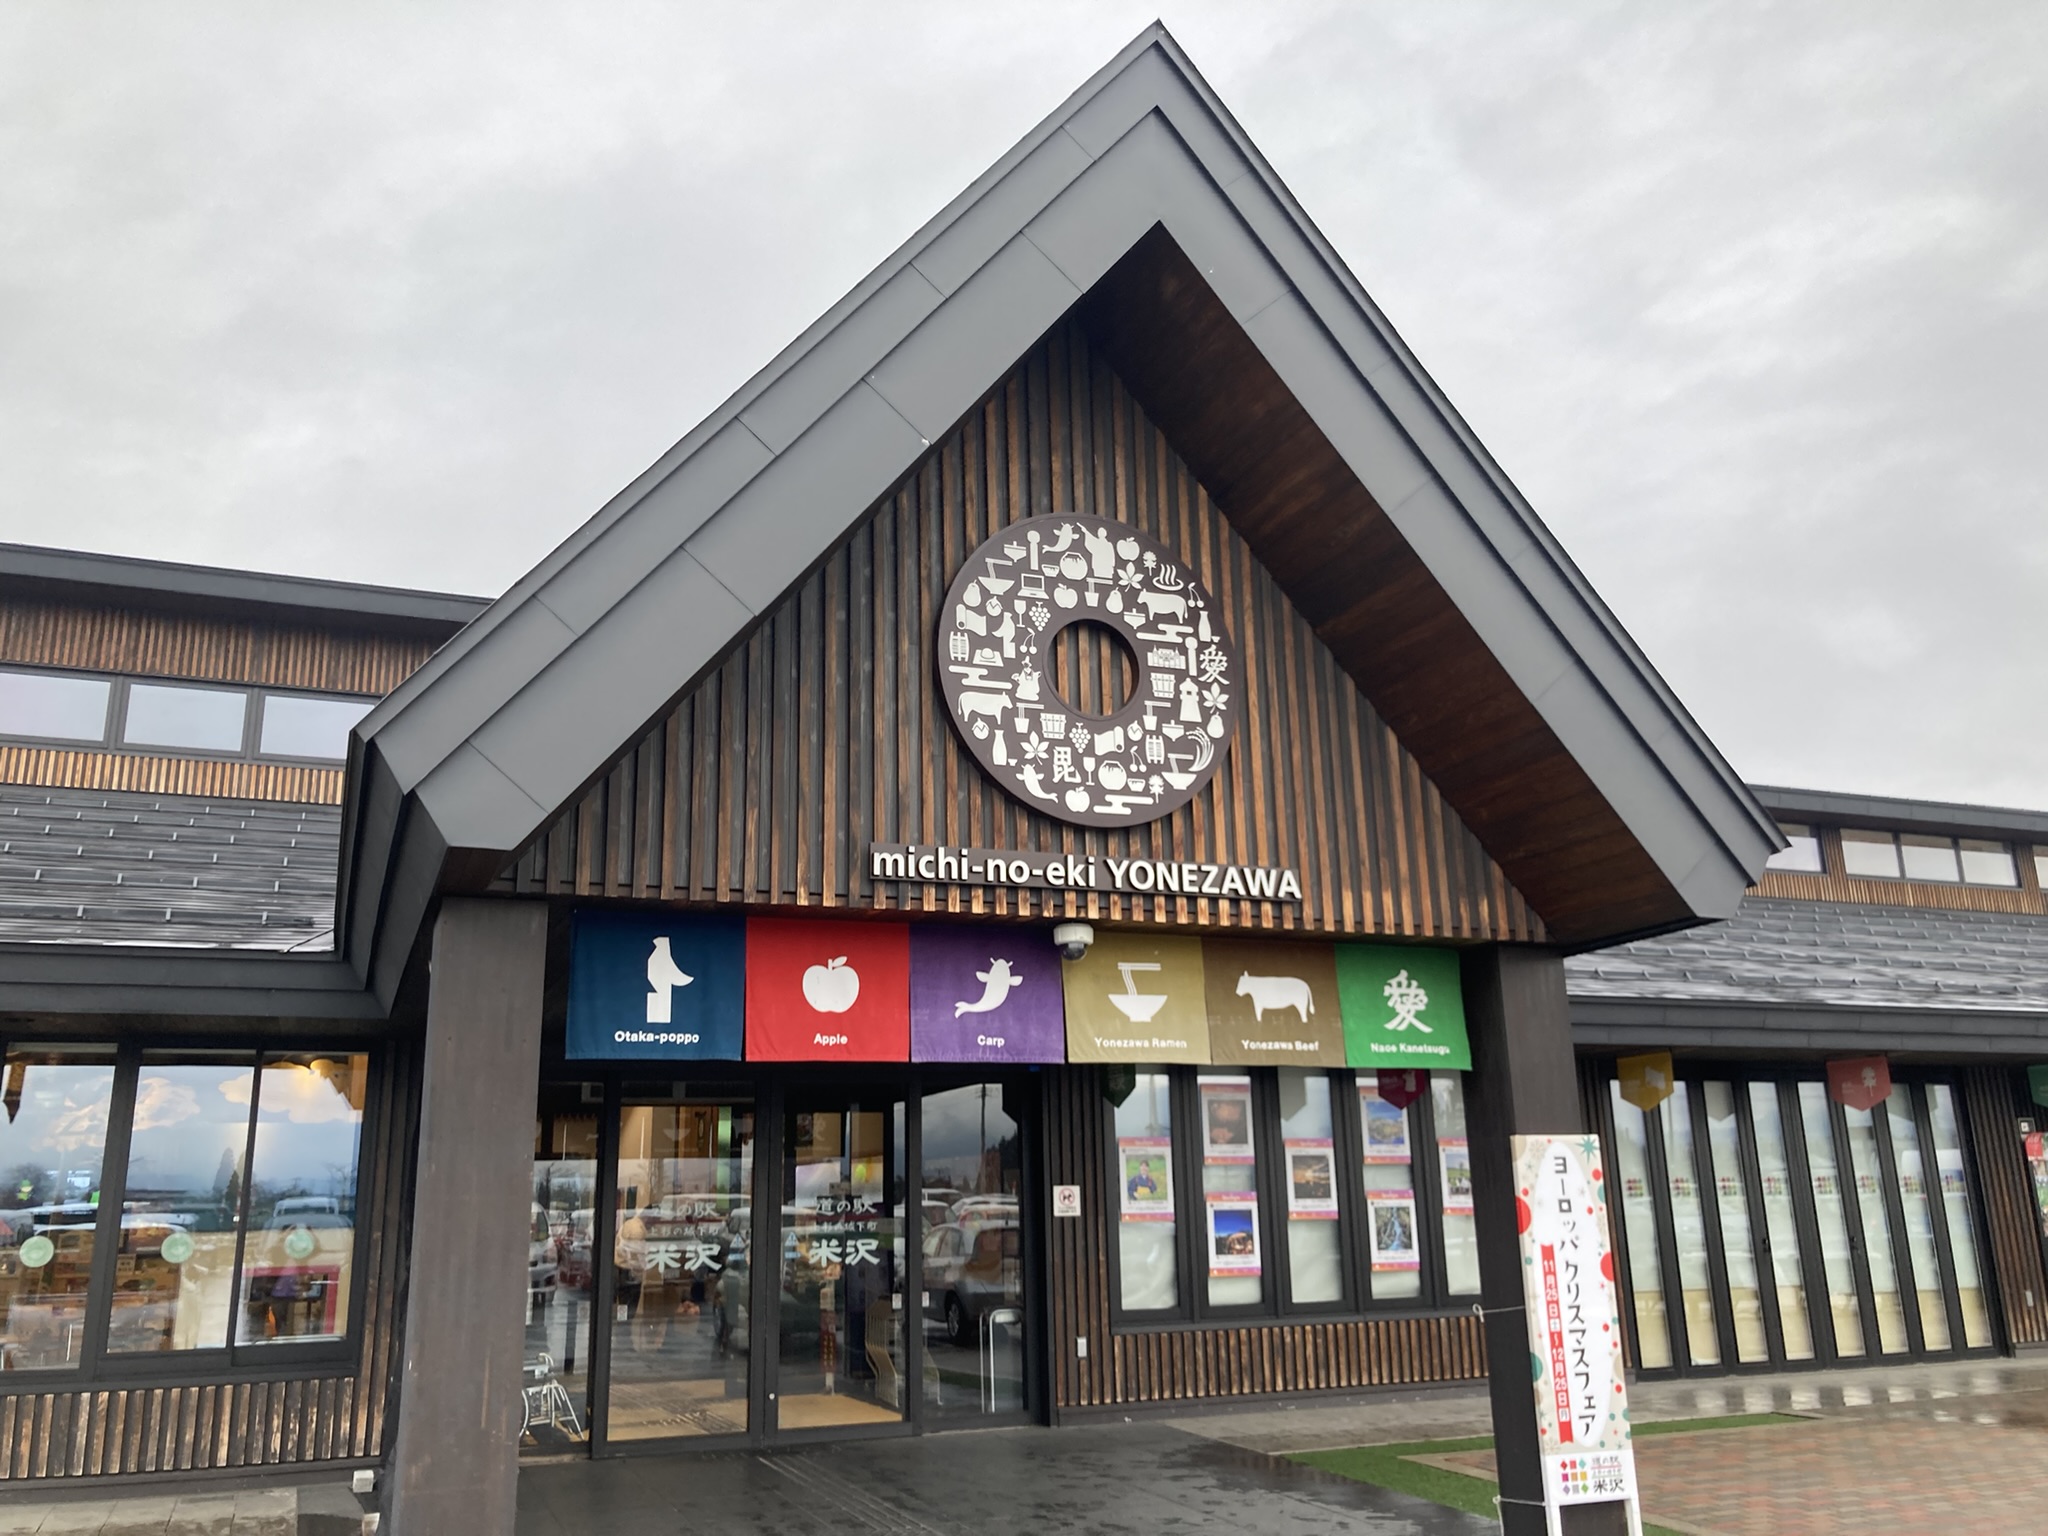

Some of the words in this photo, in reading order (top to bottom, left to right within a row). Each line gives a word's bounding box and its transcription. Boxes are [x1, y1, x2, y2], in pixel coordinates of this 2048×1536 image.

[1198, 644, 1231, 685] 愛
[1052, 746, 1082, 784] 毘
[872, 846, 1096, 887] michi-no-eki
[1106, 858, 1302, 899] YONEZAWA
[1384, 969, 1433, 1033] 愛
[614, 1031, 699, 1044] Otaka-poppo
[814, 1033, 848, 1045] Apple
[977, 1034, 1005, 1047] Carp
[1095, 1037, 1149, 1048] Yonezawa
[1152, 1037, 1187, 1048] Ramen
[1241, 1039, 1293, 1051] Yonezawa
[1295, 1040, 1319, 1051] Beef
[816, 1199, 877, 1216] 道の駅
[645, 1243, 722, 1273] 米沢
[808, 1238, 880, 1267] 米沢
